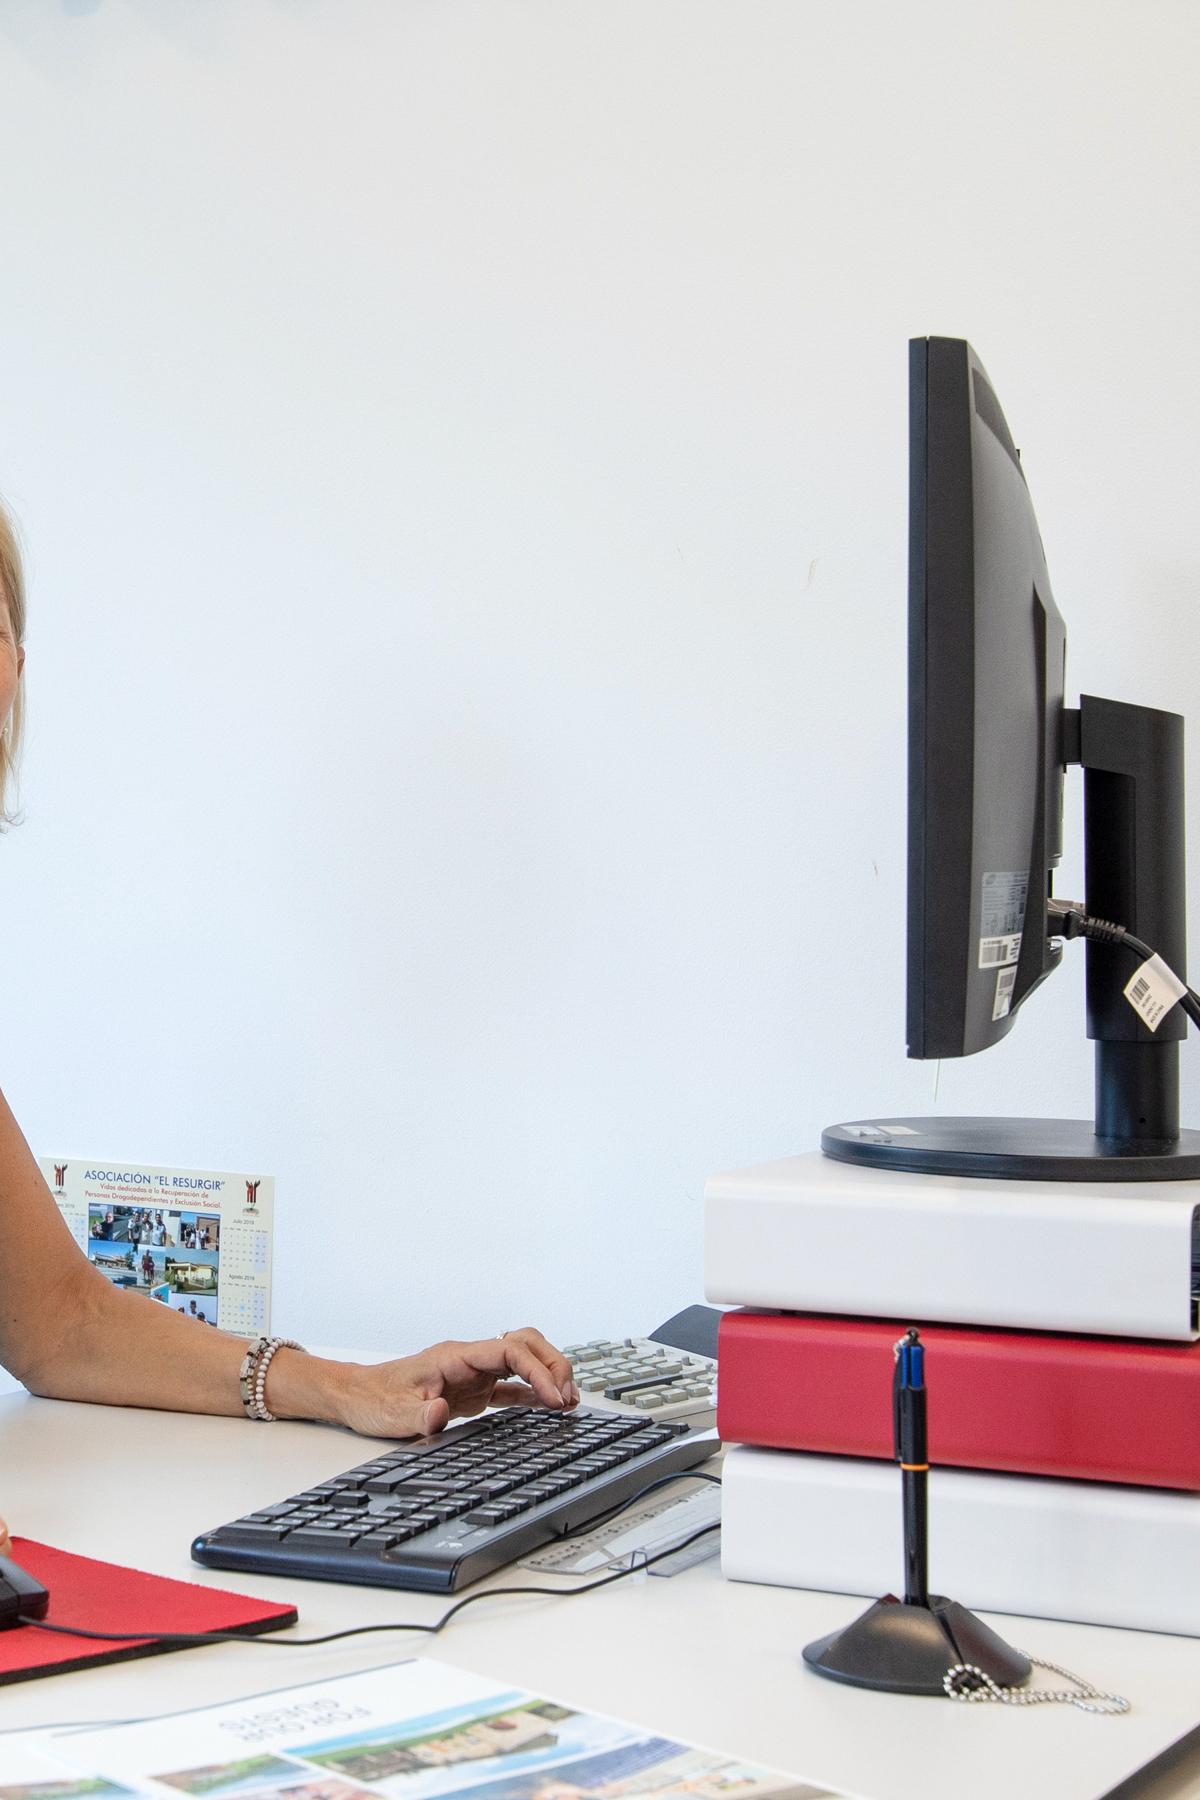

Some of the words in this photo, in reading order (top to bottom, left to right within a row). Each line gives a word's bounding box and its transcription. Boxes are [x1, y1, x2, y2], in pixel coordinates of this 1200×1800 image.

[84, 1170, 151, 1184] ASOCIACIÓN
[84, 1190, 110, 1198] Personas
[111, 1193, 169, 1204] Drogodependientes
[174, 1198, 202, 1206] Exclusión
[117, 1184, 147, 1193] dedicadas
[161, 1187, 200, 1198] Recuperación
[201, 1191, 209, 1199] de
